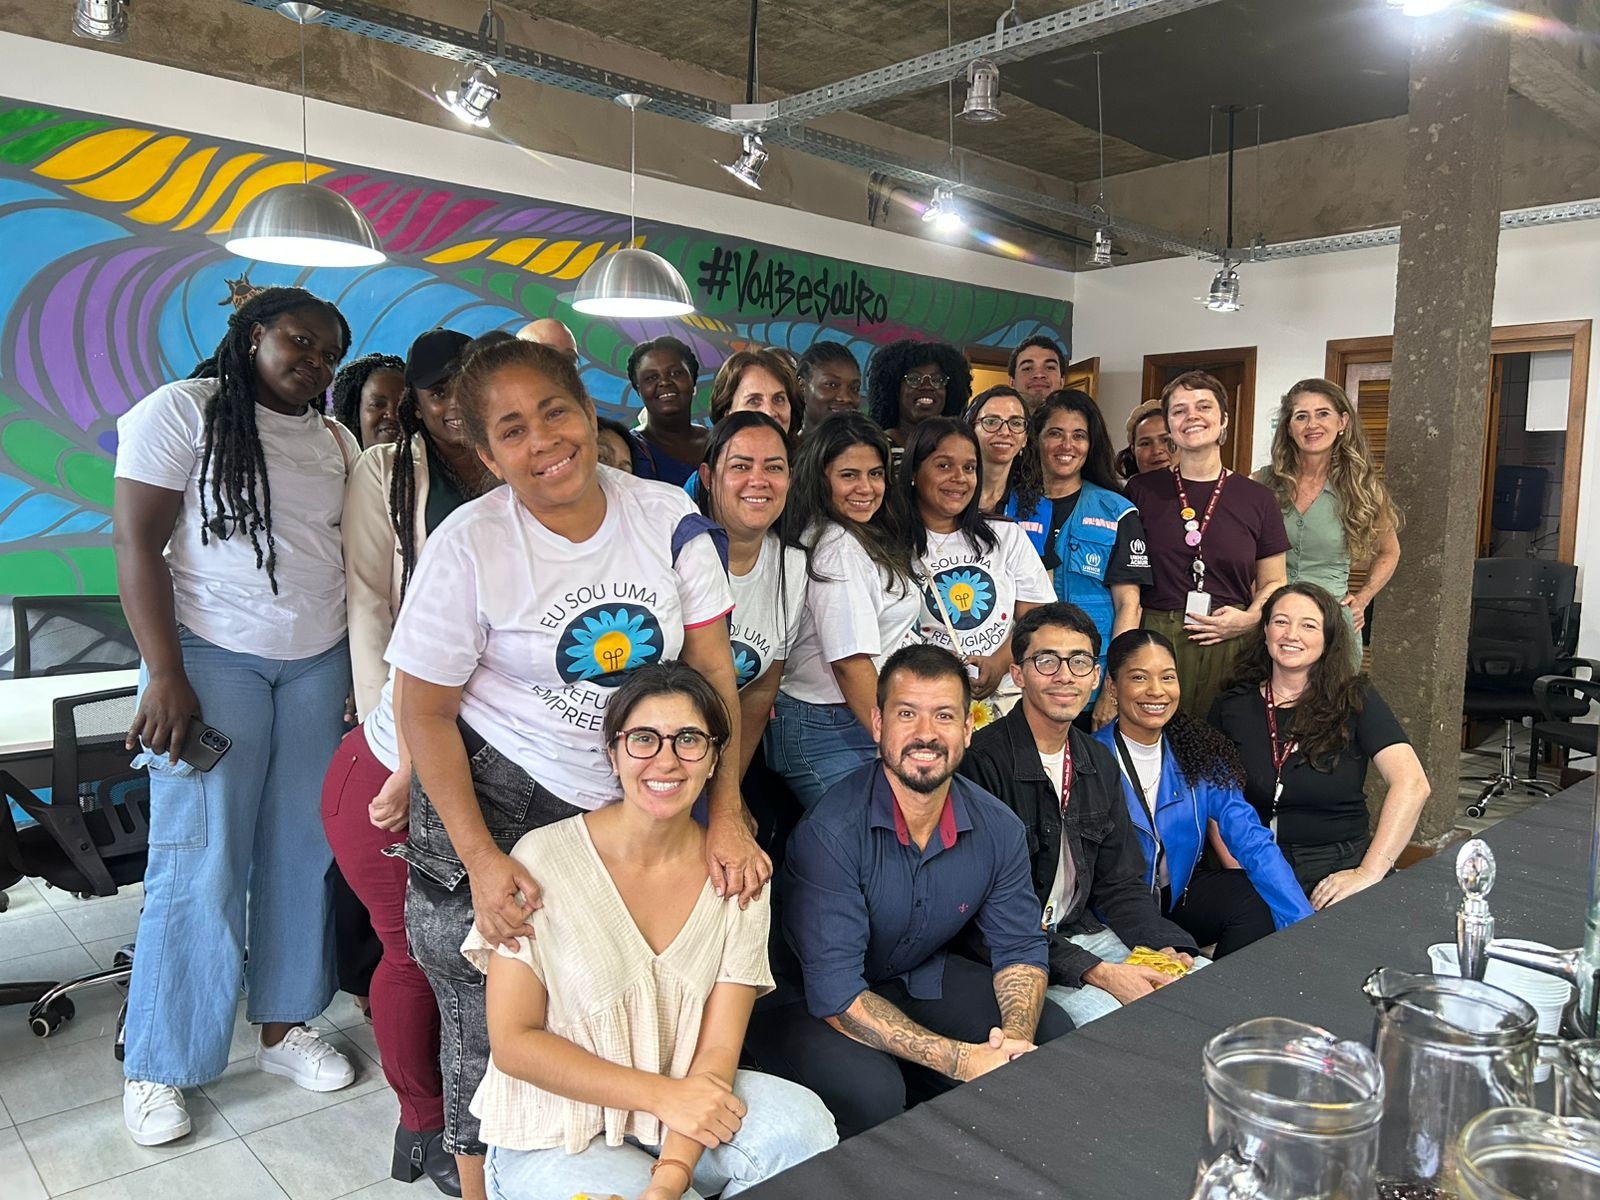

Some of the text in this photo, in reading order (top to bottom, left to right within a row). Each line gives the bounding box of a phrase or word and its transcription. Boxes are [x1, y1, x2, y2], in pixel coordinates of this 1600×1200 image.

[930, 554, 992, 571] SOU UMA
[540, 582, 658, 629] EU SOU UMA
[744, 627, 771, 657] UMA
